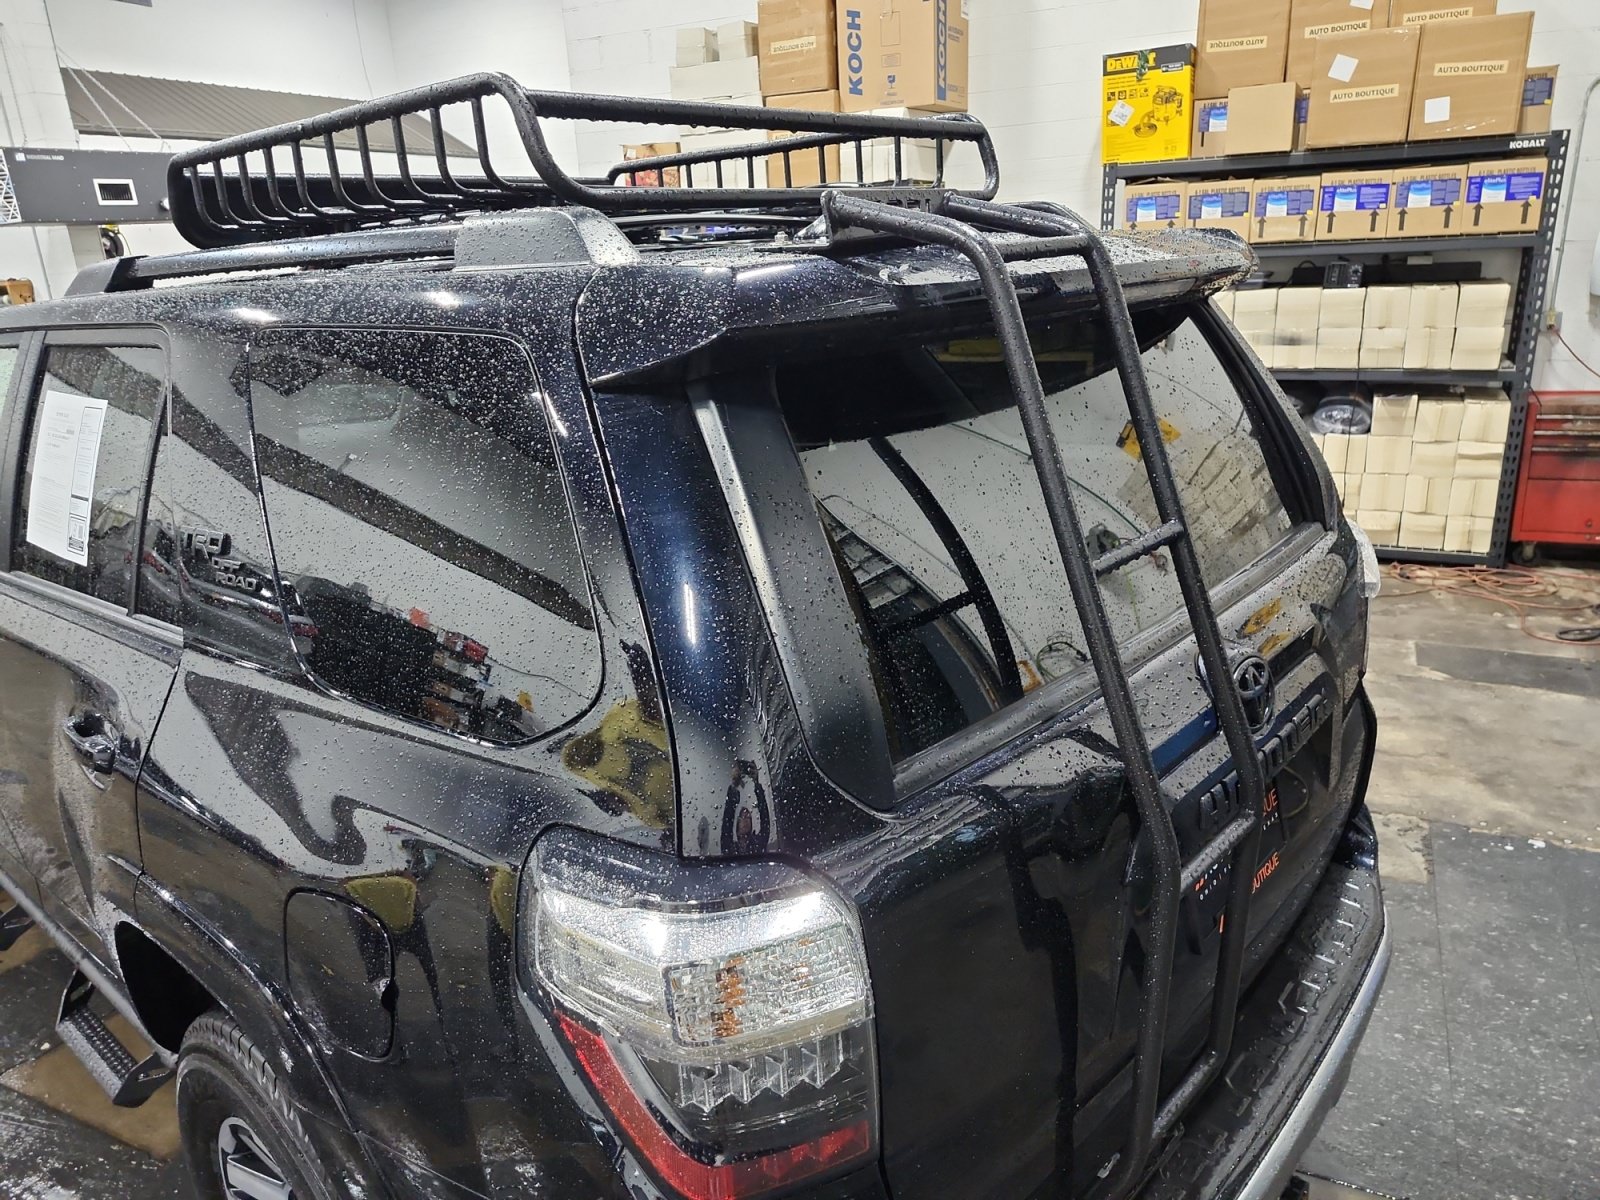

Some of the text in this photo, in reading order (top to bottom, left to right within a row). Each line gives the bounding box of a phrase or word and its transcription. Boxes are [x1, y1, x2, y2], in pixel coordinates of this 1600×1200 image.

[1406, 9, 1470, 23] AUTO BOUTIQUE
[1309, 22, 1368, 36] AUTO BOUTIQUE
[1209, 38, 1265, 49] AUTO BOUTIQUE
[846, 9, 863, 96] KOCH
[1106, 52, 1156, 72] DEWT
[1437, 63, 1505, 74] AUTO BOUTIQUE
[1332, 87, 1395, 101] AUTO BOUTIQUE
[1509, 138, 1546, 149] KOBALT
[212, 556, 242, 572] OFF
[215, 571, 257, 590] ROAD
